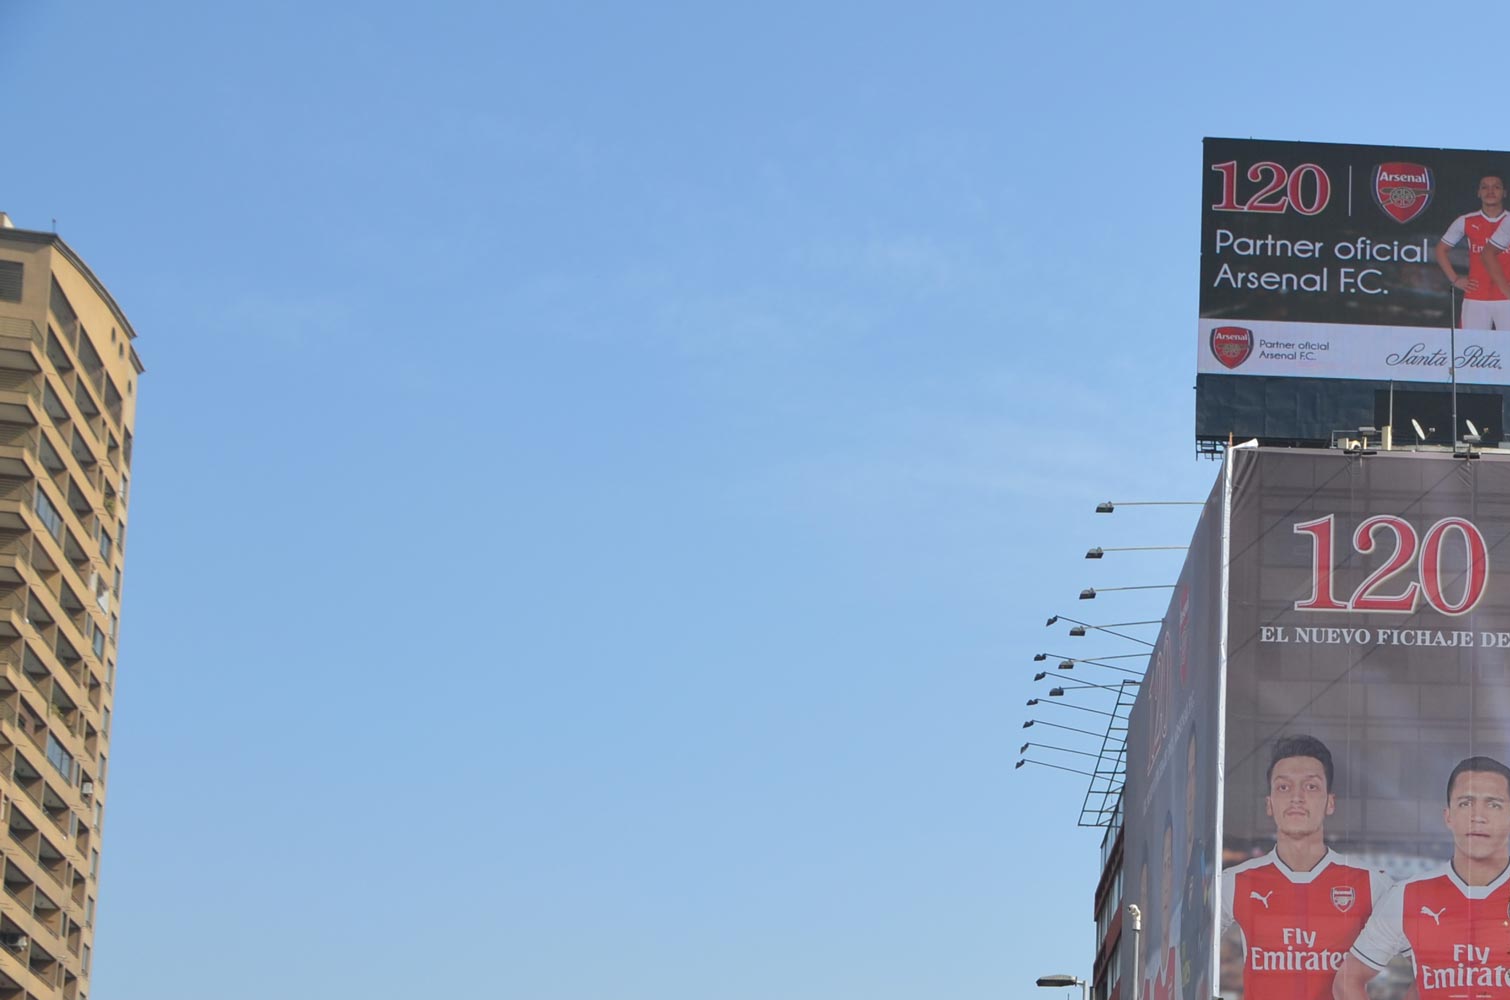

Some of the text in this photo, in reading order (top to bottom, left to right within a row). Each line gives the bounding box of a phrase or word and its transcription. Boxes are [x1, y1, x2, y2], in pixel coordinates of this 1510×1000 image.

[1379, 171, 1426, 183] Arsenal
[1212, 160, 1331, 216] 120
[1216, 229, 1428, 262] Partner oficial
[1213, 263, 1388, 294] Arsenal F.C.
[1216, 332, 1248, 341] Arsenal
[1259, 339, 1330, 351] Partner oficial
[1259, 350, 1316, 361] Arsenal F.C.
[1386, 343, 1447, 367] Santa
[1294, 513, 1489, 616] 120
[1260, 626, 1289, 643] EL
[1295, 627, 1371, 645] NUEVO
[1376, 629, 1474, 648] FICHAJE
[1282, 927, 1316, 948] Fly
[1453, 943, 1490, 964] Fly
